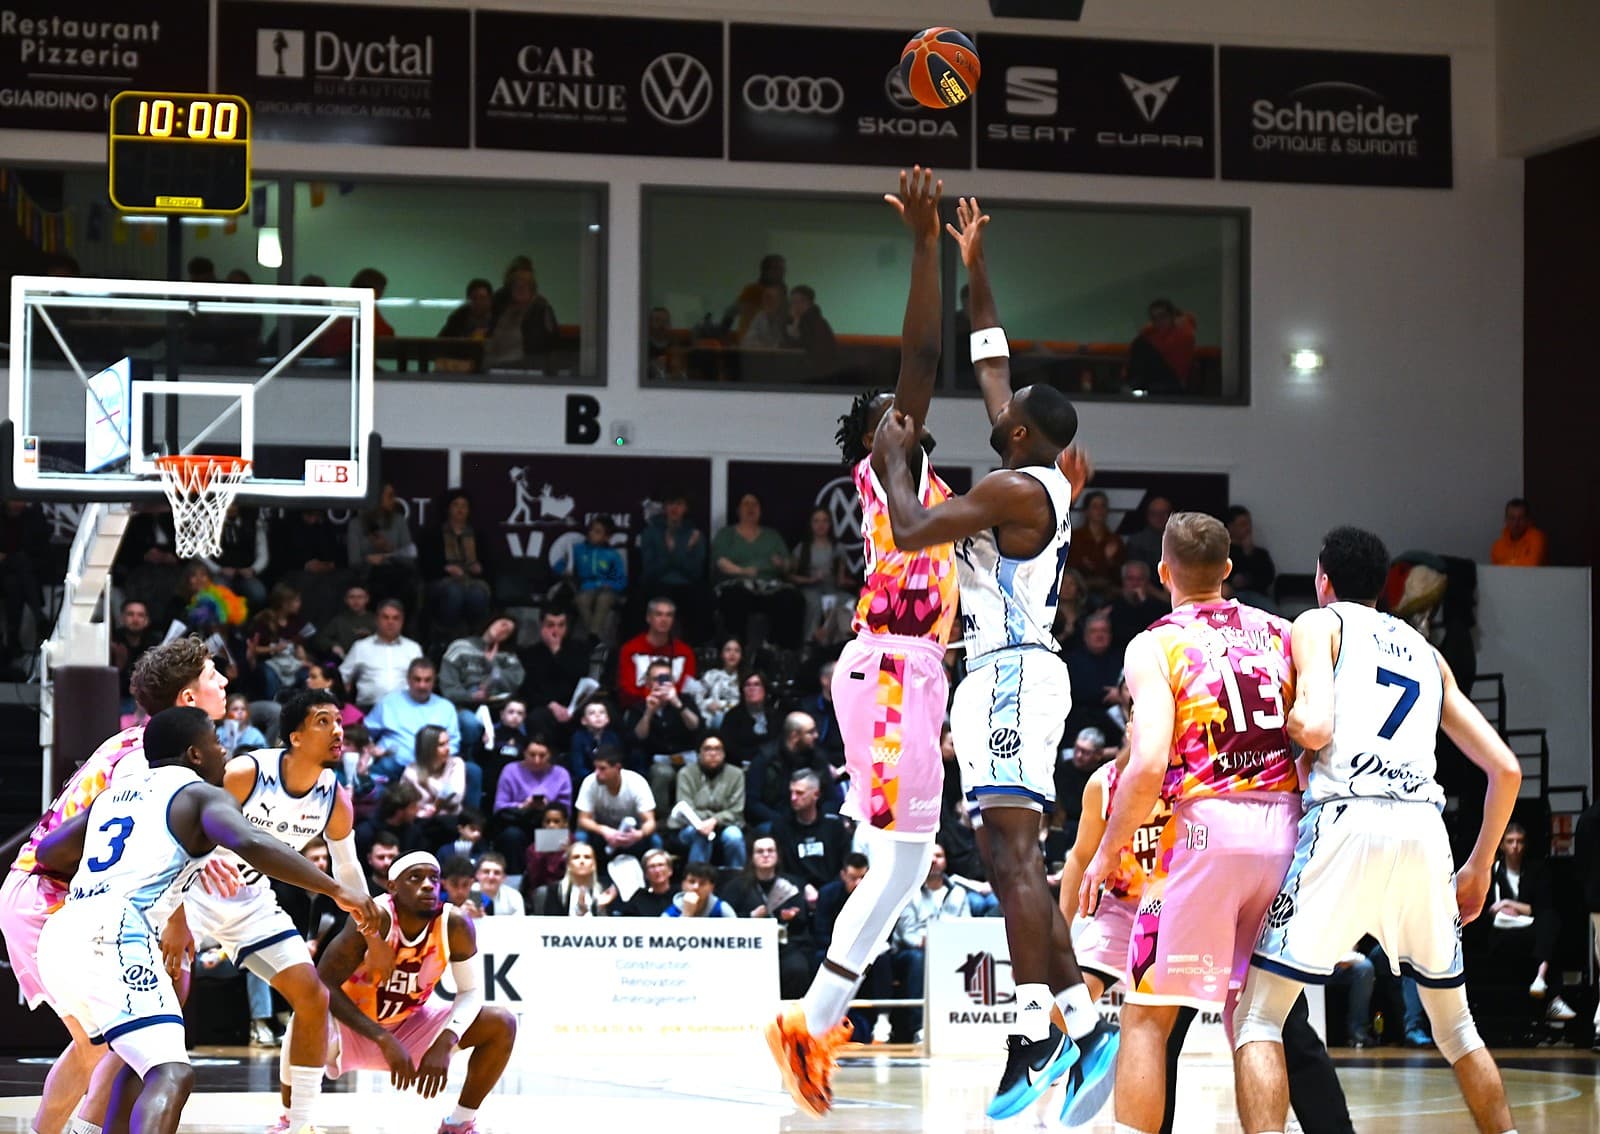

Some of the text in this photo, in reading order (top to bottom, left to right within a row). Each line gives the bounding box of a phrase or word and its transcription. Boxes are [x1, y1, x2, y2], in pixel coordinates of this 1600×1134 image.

[1, 10, 160, 41] Restaurant
[20, 38, 139, 67] Pizzeria
[314, 31, 432, 80] Dyctal
[517, 45, 594, 77] CAR
[0, 88, 97, 110] GIARDINO
[489, 77, 626, 111] AVENUE
[137, 100, 238, 139] 10:00
[857, 116, 958, 137] SKODA
[987, 123, 1076, 142] SEAT
[1252, 99, 1419, 136] Schneider
[1096, 131, 1204, 148] CUPRA
[1252, 134, 1327, 152] OPTIQUE
[1330, 138, 1343, 153] &
[565, 394, 601, 444] B
[1209, 654, 1286, 733] 13
[1375, 665, 1420, 740] 7
[87, 815, 135, 872] 3
[1183, 819, 1208, 852] 13
[541, 935, 763, 951] TRAVAUX DE MAÇONNERIE
[616, 959, 689, 969] Construction
[378, 999, 403, 1019] 11
[949, 1011, 1017, 1024] RAVALE
